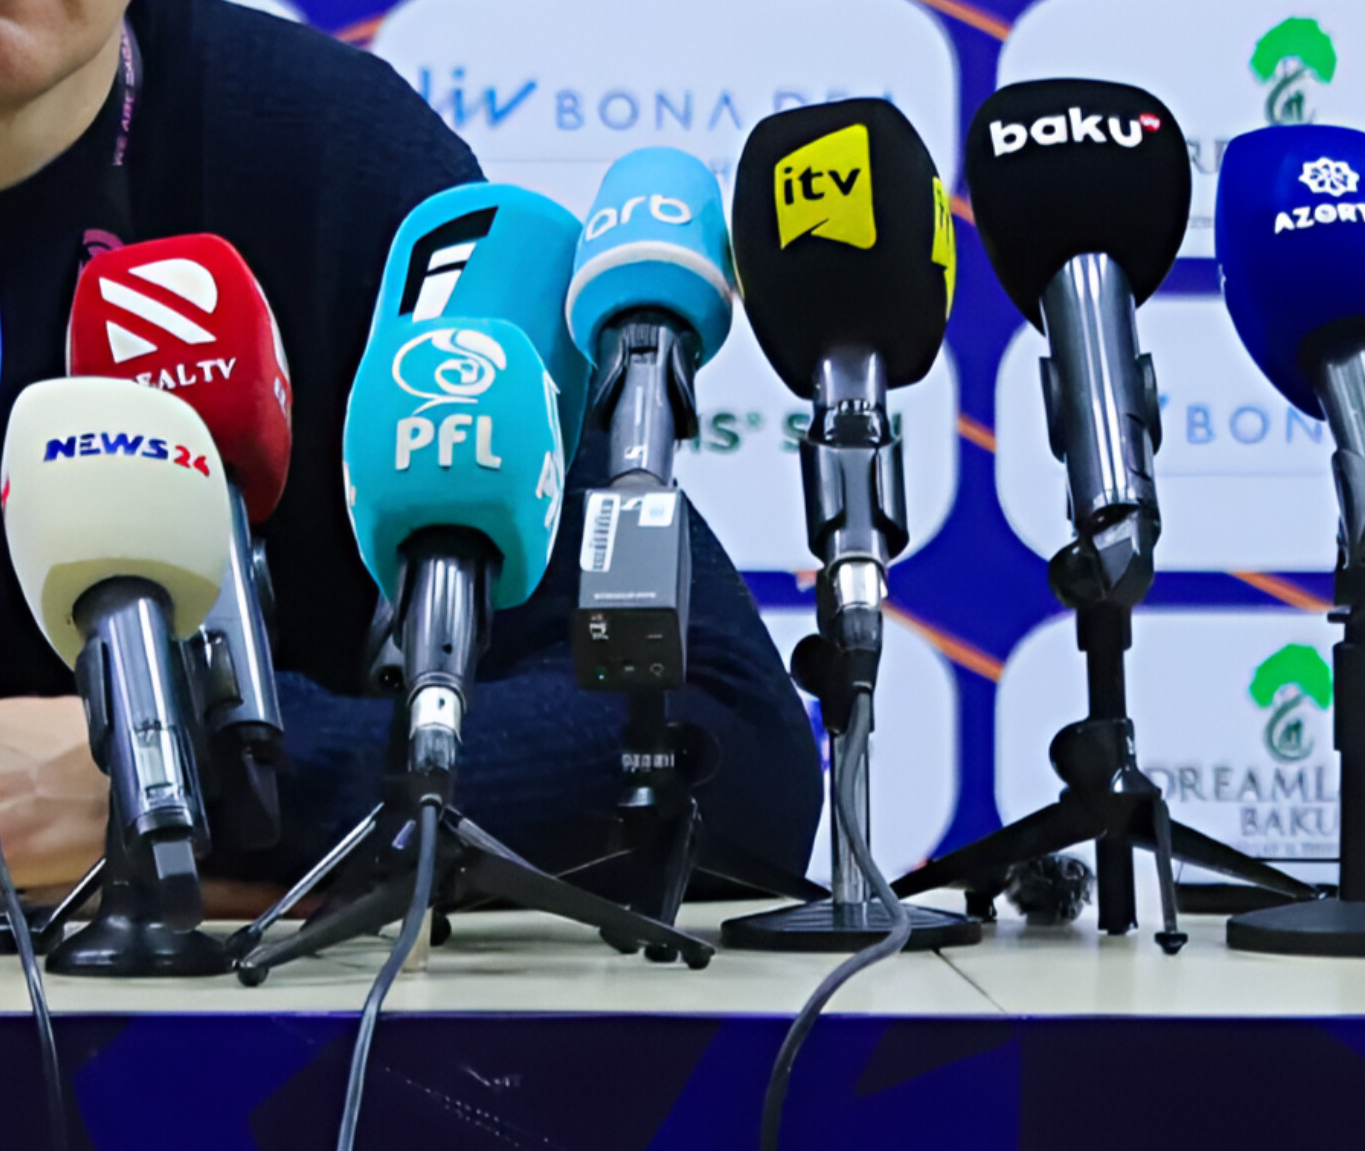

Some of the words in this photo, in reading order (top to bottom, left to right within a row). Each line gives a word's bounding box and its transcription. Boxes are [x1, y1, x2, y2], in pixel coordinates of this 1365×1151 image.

[555, 89, 742, 131] BONA
[989, 107, 1143, 157] baku
[783, 165, 862, 206] itv
[394, 413, 503, 471] PFL
[1186, 403, 1323, 445] BON
[1145, 766, 1339, 802] DREAML
